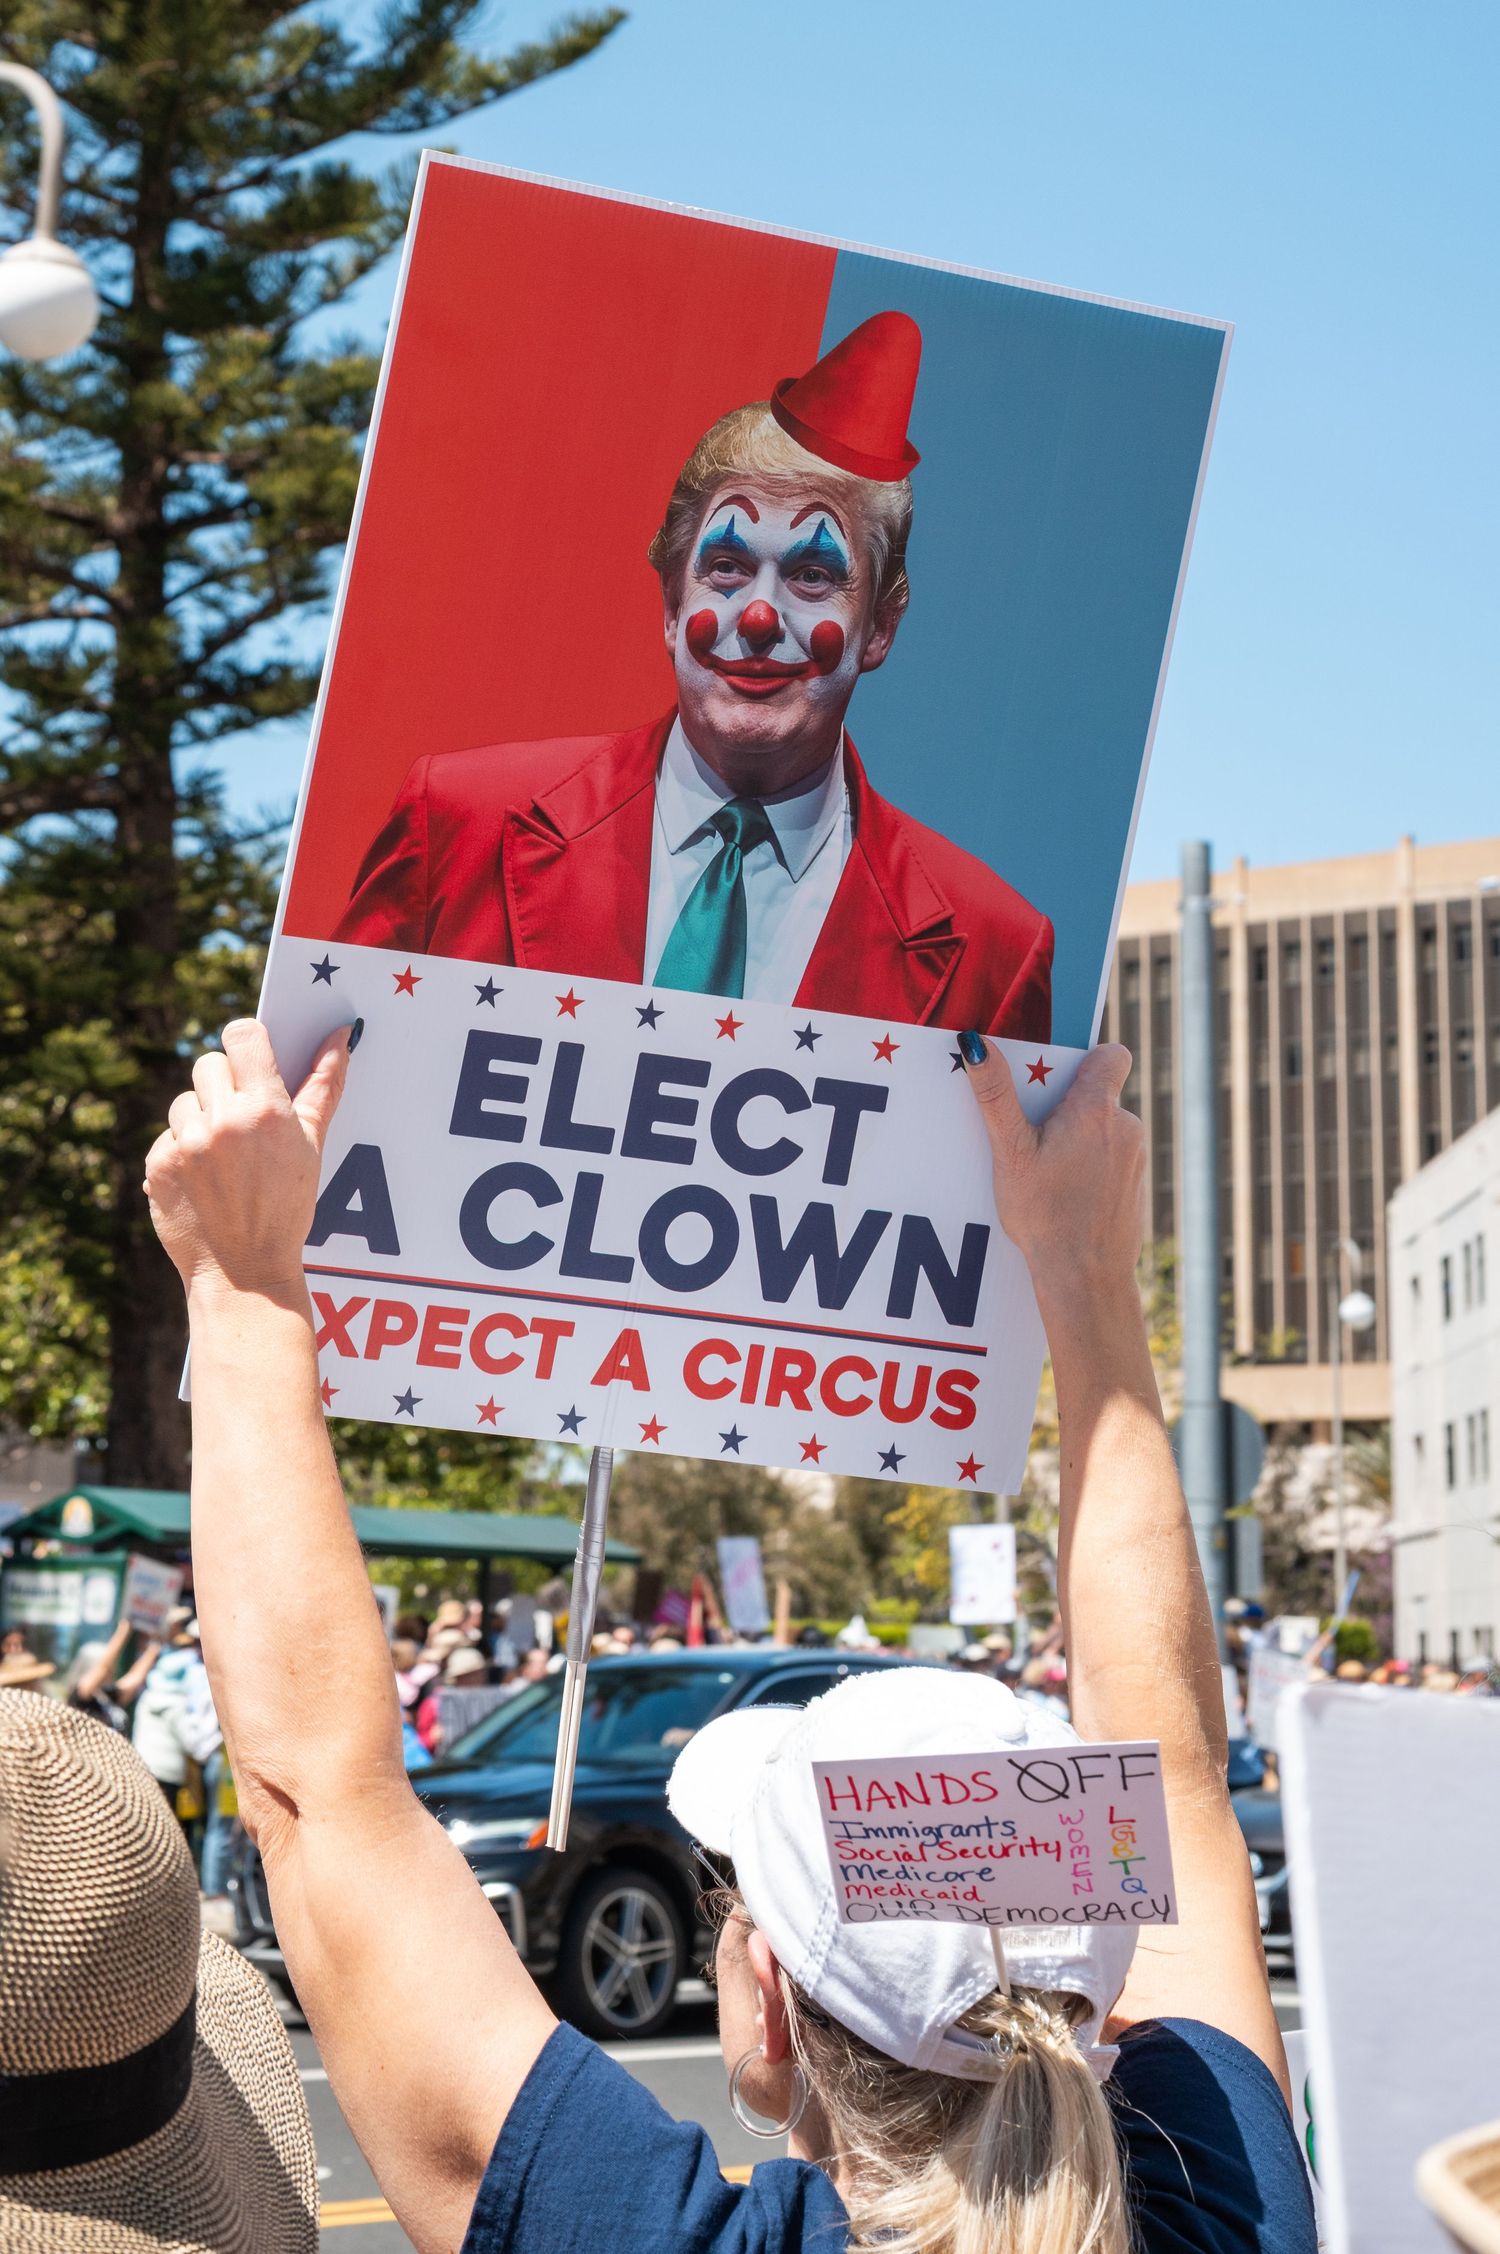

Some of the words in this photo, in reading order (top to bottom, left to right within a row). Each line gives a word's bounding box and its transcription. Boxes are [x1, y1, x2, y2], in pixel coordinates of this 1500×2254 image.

[448, 1029, 889, 1187] ELECT
[304, 1143, 401, 1256] A
[459, 1161, 991, 1328] CLOWN
[311, 1291, 576, 1380] XPECT
[590, 1328, 651, 1392] A
[682, 1338, 980, 1431] CIRCUS
[824, 1771, 999, 1812] HANDS
[829, 1815, 1017, 1847] Immigrants
[834, 1841, 928, 1863] Social
[936, 1835, 1062, 1863] Security
[1108, 1805, 1148, 1894] LGBTQ
[846, 1899, 938, 1922] OUR
